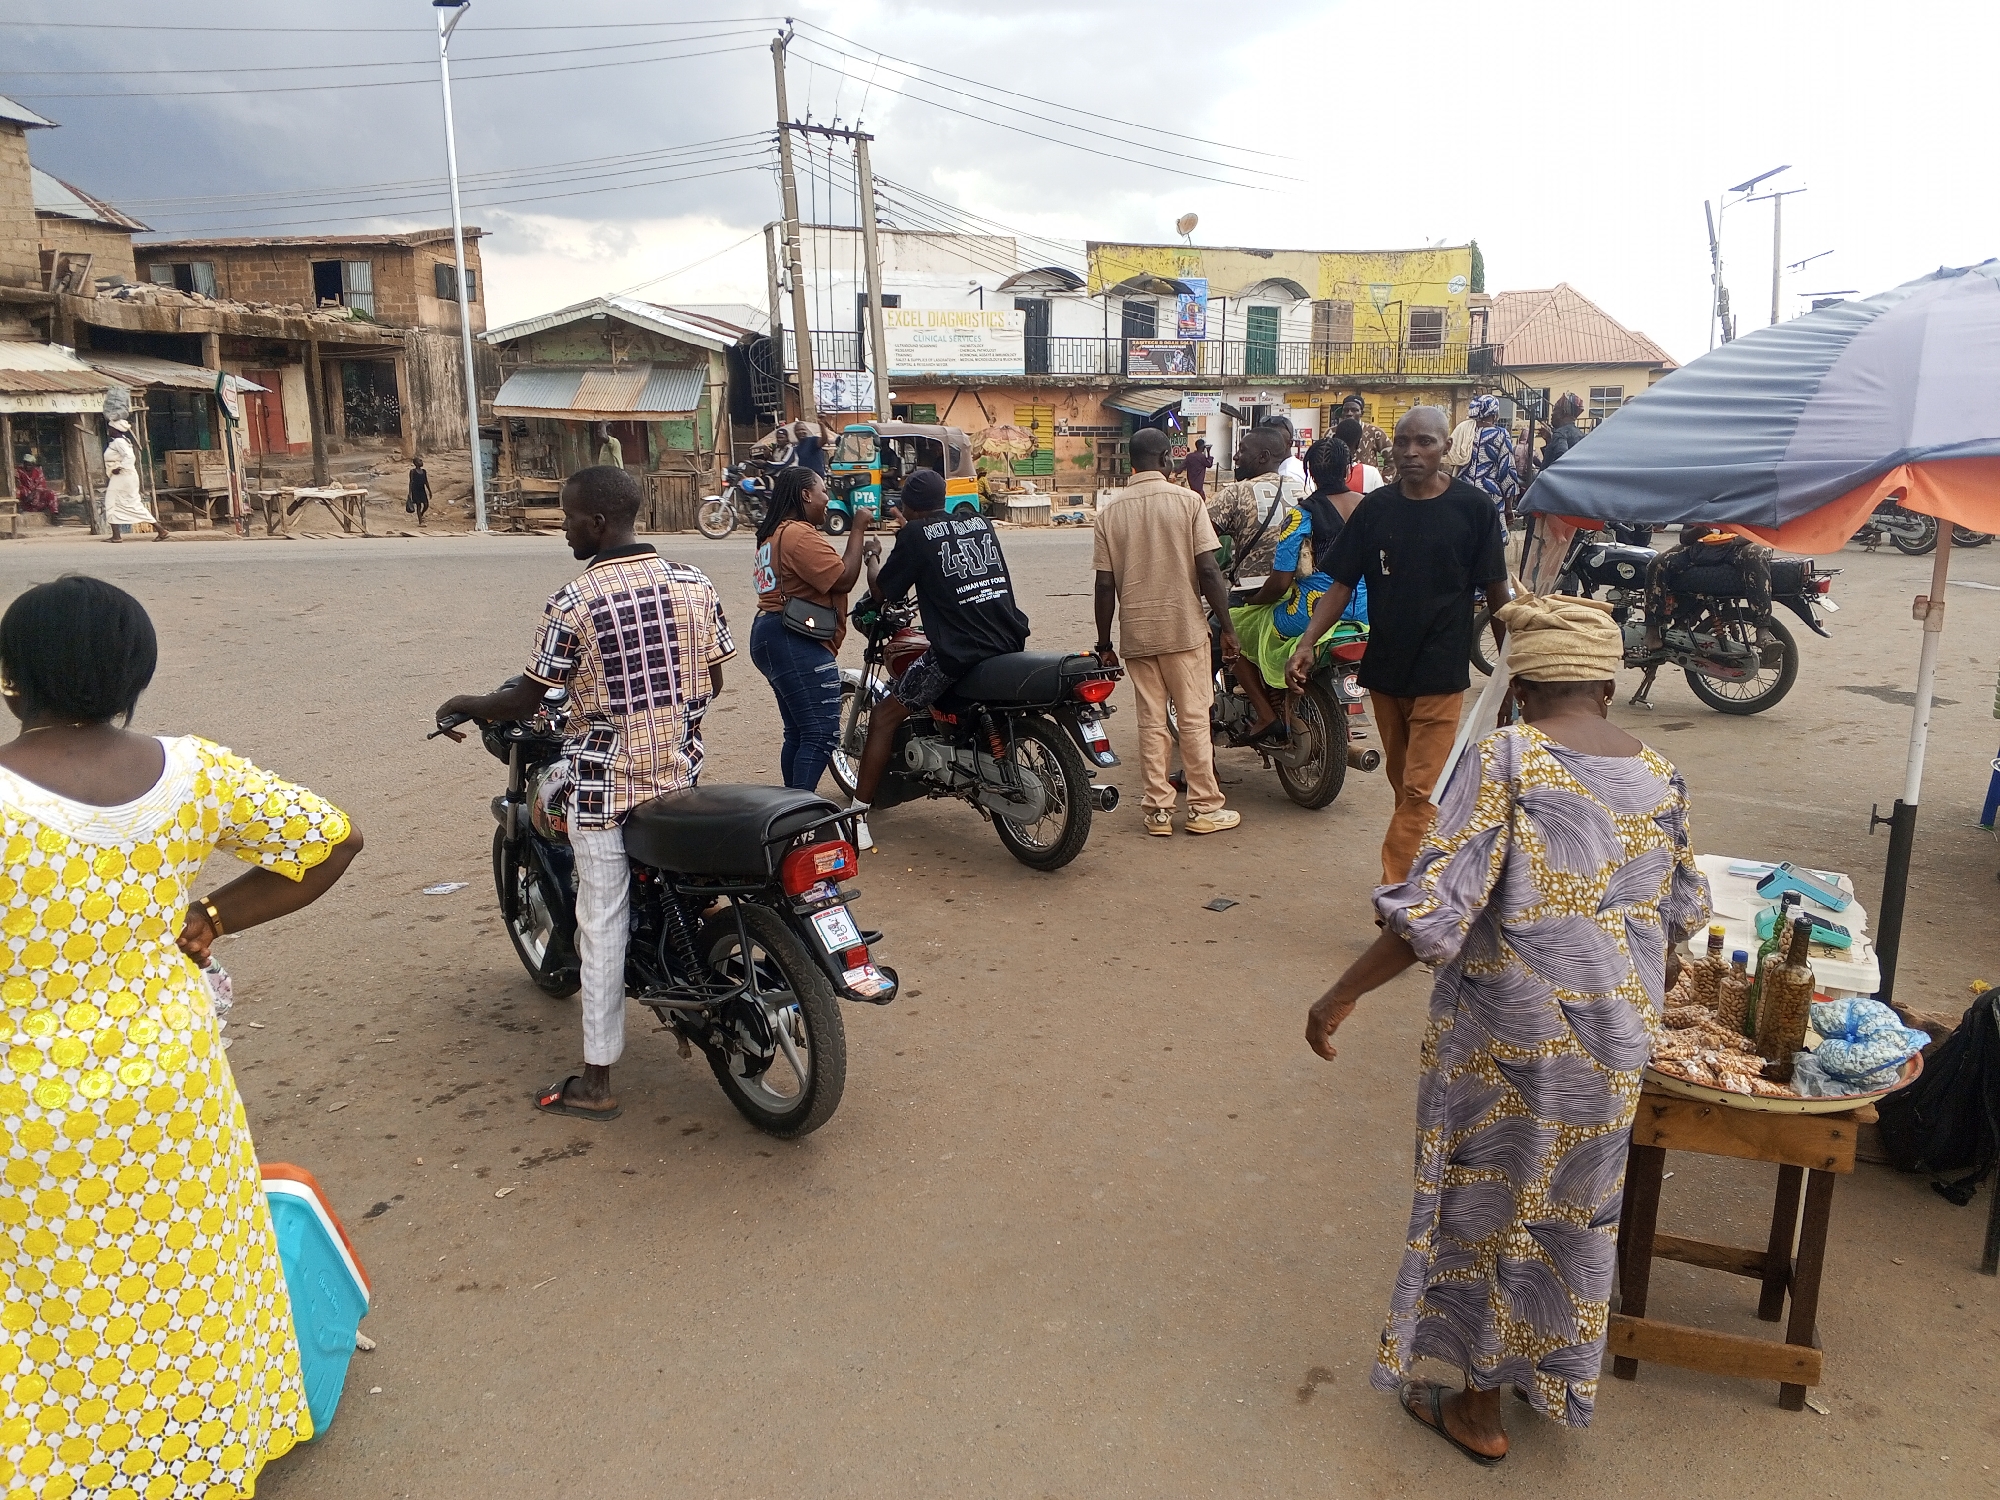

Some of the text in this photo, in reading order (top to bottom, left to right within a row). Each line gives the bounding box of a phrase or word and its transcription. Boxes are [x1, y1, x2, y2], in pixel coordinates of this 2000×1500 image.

[888, 310, 924, 327] EXCEL
[928, 311, 1005, 328] DIAGNOSTICS
[913, 335, 982, 343] CLINICAL SERVICES
[923, 521, 950, 540] NOT
[938, 533, 1003, 579] 404
[956, 582, 980, 594] HUMAN
[979, 579, 990, 587] NOT
